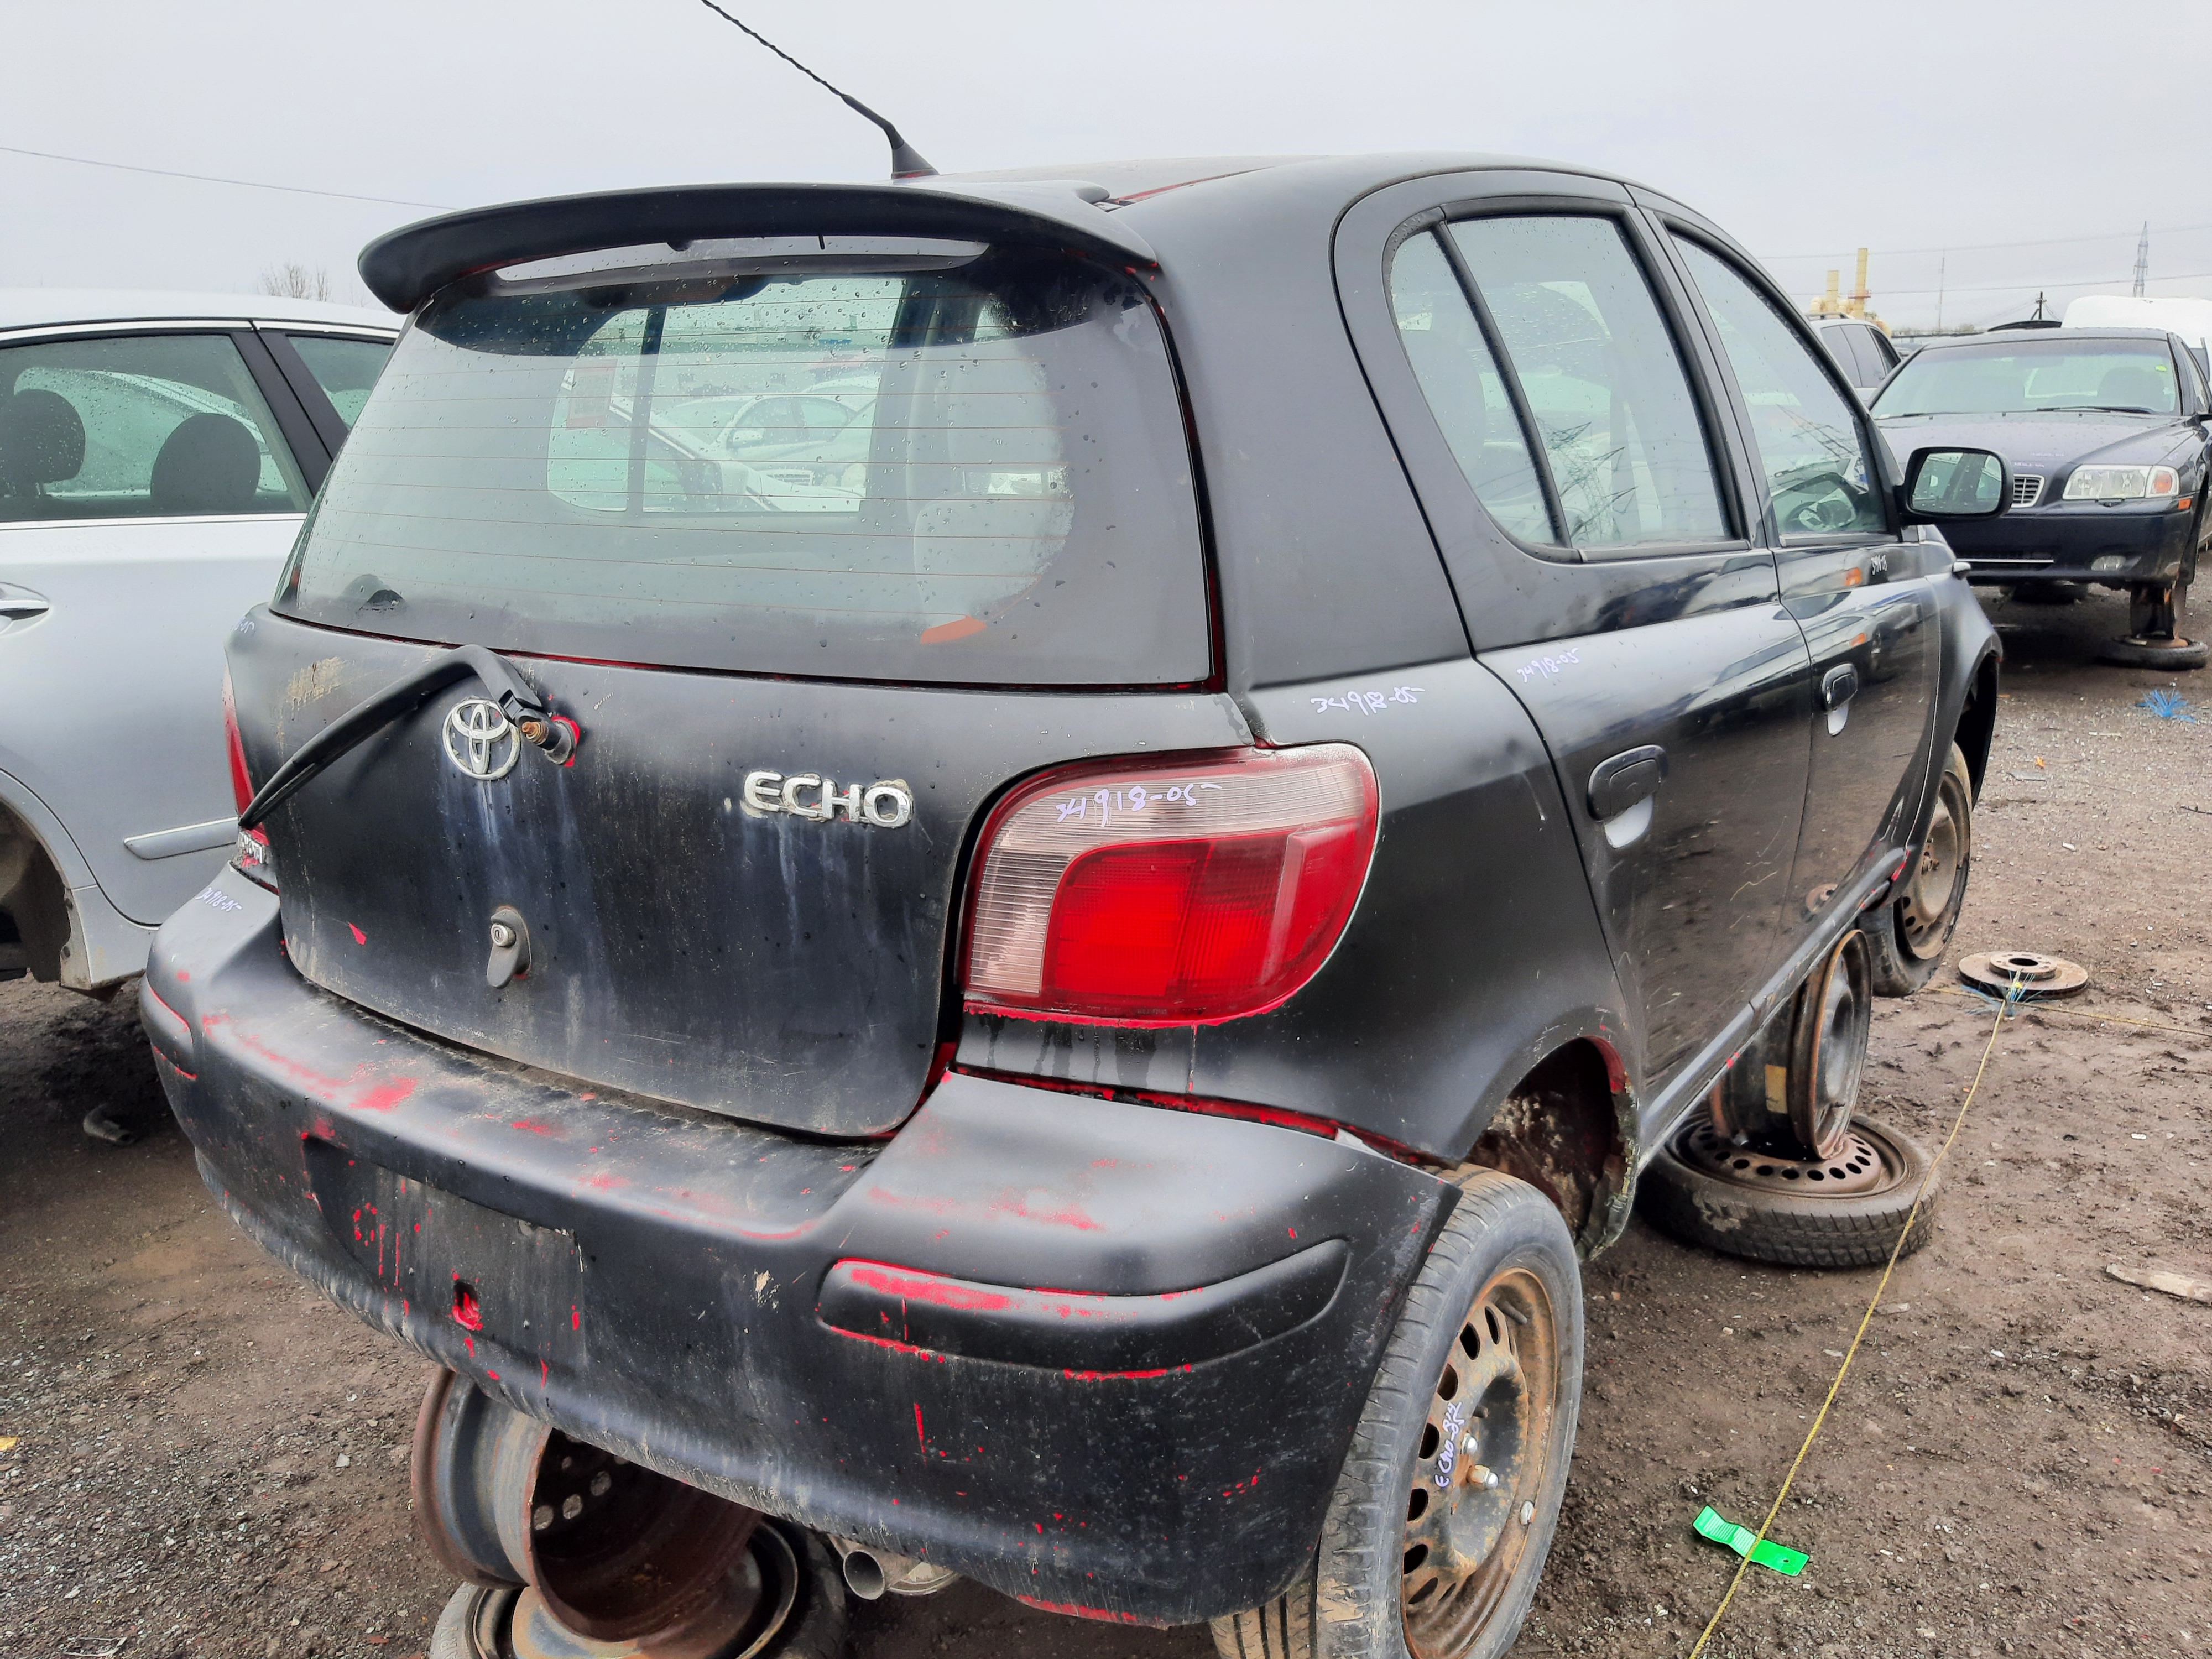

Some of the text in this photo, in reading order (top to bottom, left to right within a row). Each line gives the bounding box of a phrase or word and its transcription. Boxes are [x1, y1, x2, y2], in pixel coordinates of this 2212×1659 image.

[1310, 687, 1425, 716] 34918-05
[744, 772, 912, 828] ECHO
[1056, 783, 1222, 828] 34918-05
